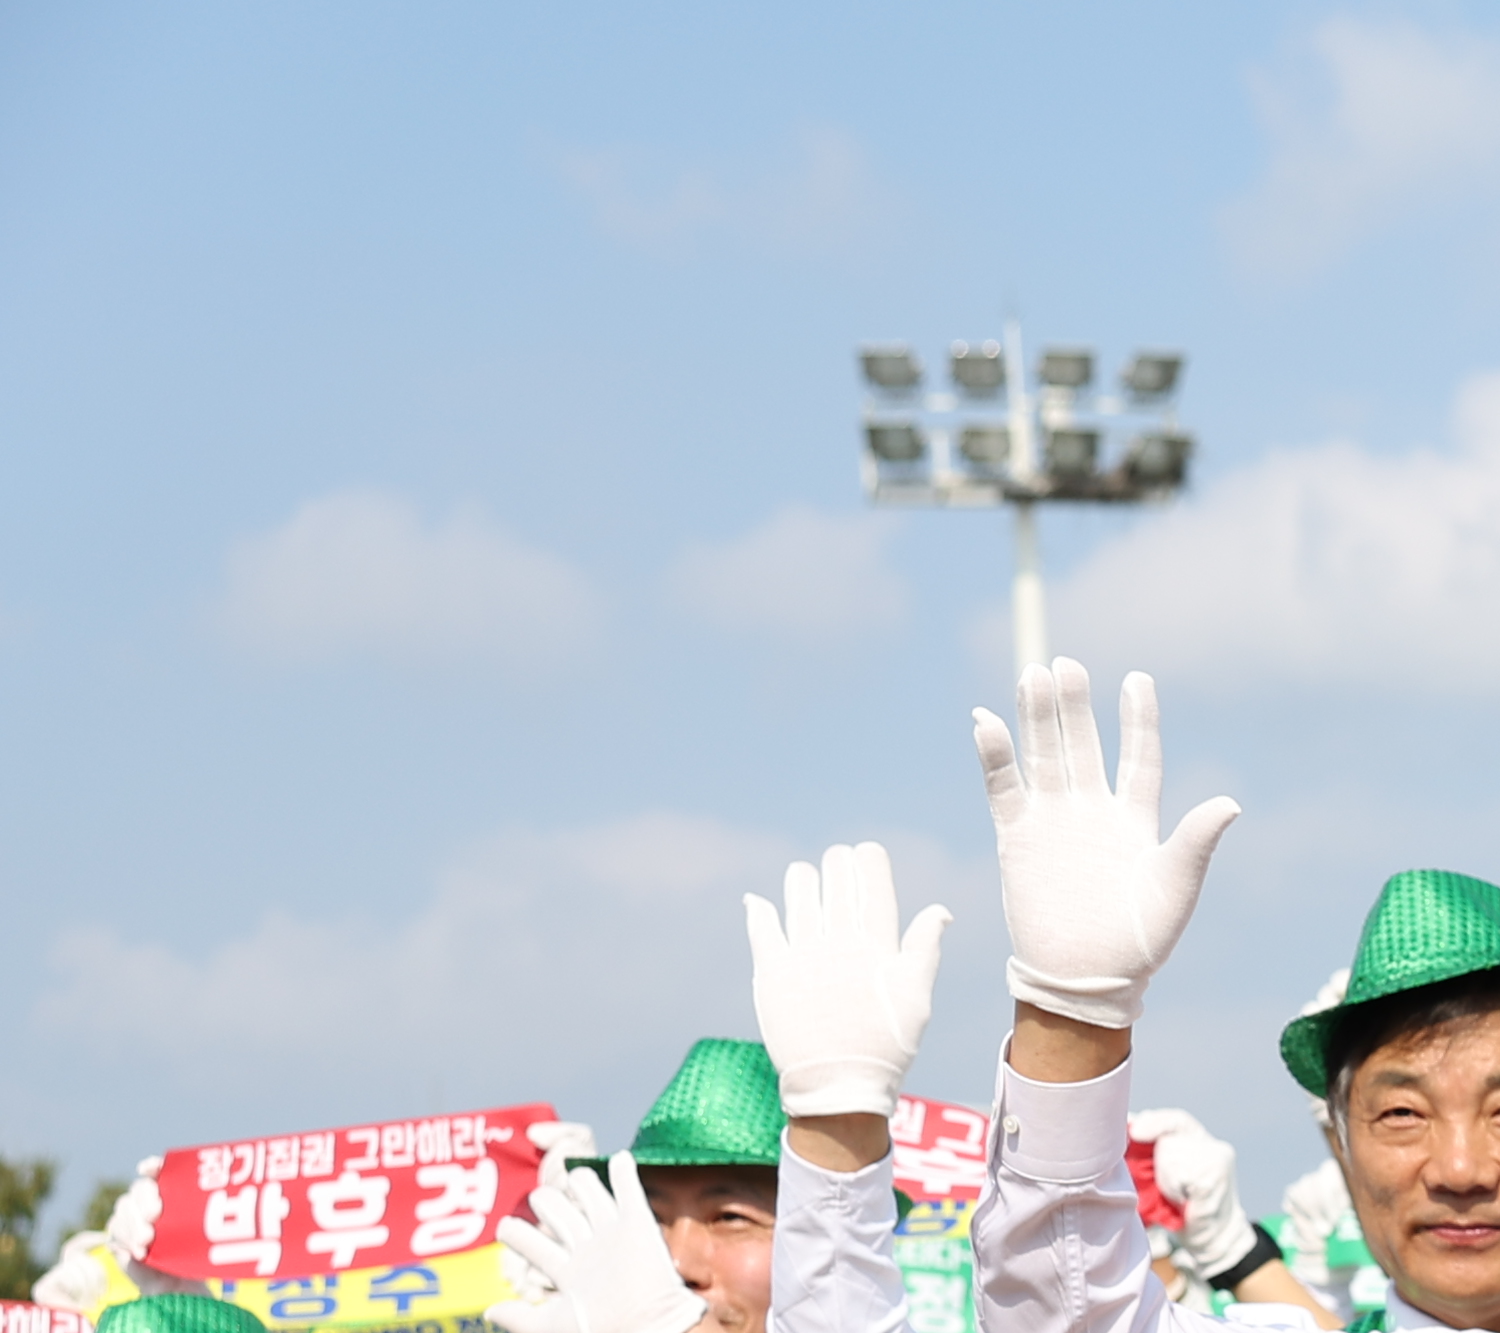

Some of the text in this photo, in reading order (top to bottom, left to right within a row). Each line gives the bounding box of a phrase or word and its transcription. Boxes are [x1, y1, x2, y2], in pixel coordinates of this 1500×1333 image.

[197, 1115, 514, 1191] 장기집권 그만해라~
[204, 1158, 499, 1275] 박후경
